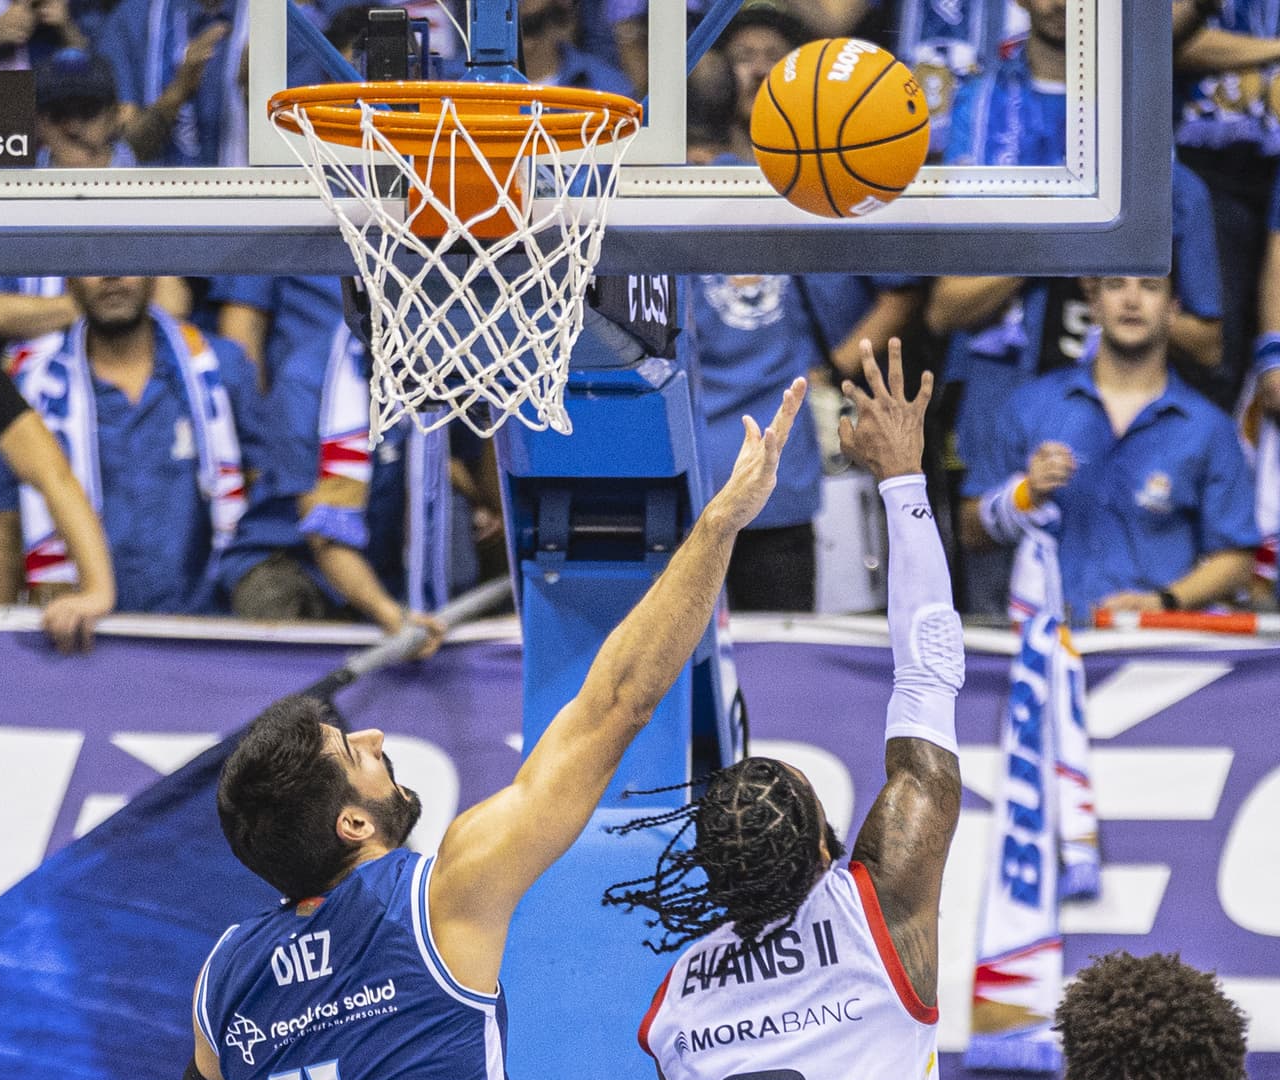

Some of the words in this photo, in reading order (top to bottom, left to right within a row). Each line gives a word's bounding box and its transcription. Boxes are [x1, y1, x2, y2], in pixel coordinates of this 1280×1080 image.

[270, 929, 334, 986] DÍEZ
[681, 929, 806, 998] EVANS
[811, 919, 840, 968] II
[343, 978, 397, 1010] salud
[689, 997, 864, 1053] MORABANC
